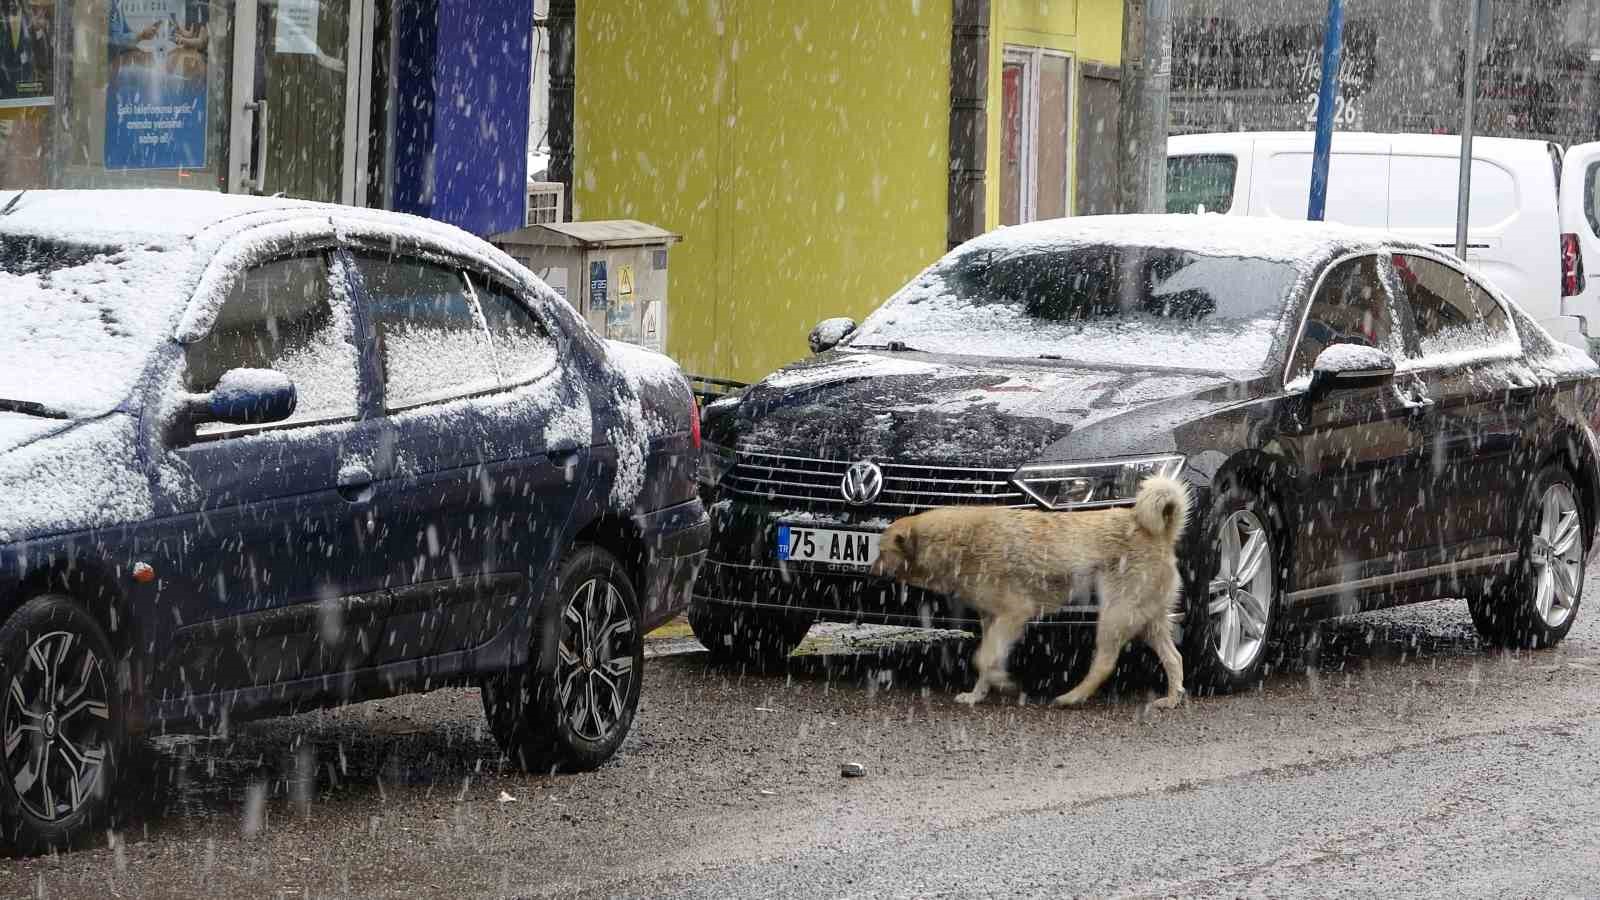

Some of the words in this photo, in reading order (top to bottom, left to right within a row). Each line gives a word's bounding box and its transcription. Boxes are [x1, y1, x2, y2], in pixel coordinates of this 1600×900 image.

[1307, 93, 1356, 123] 226
[790, 529, 816, 557] 75
[829, 533, 870, 562] AAN
